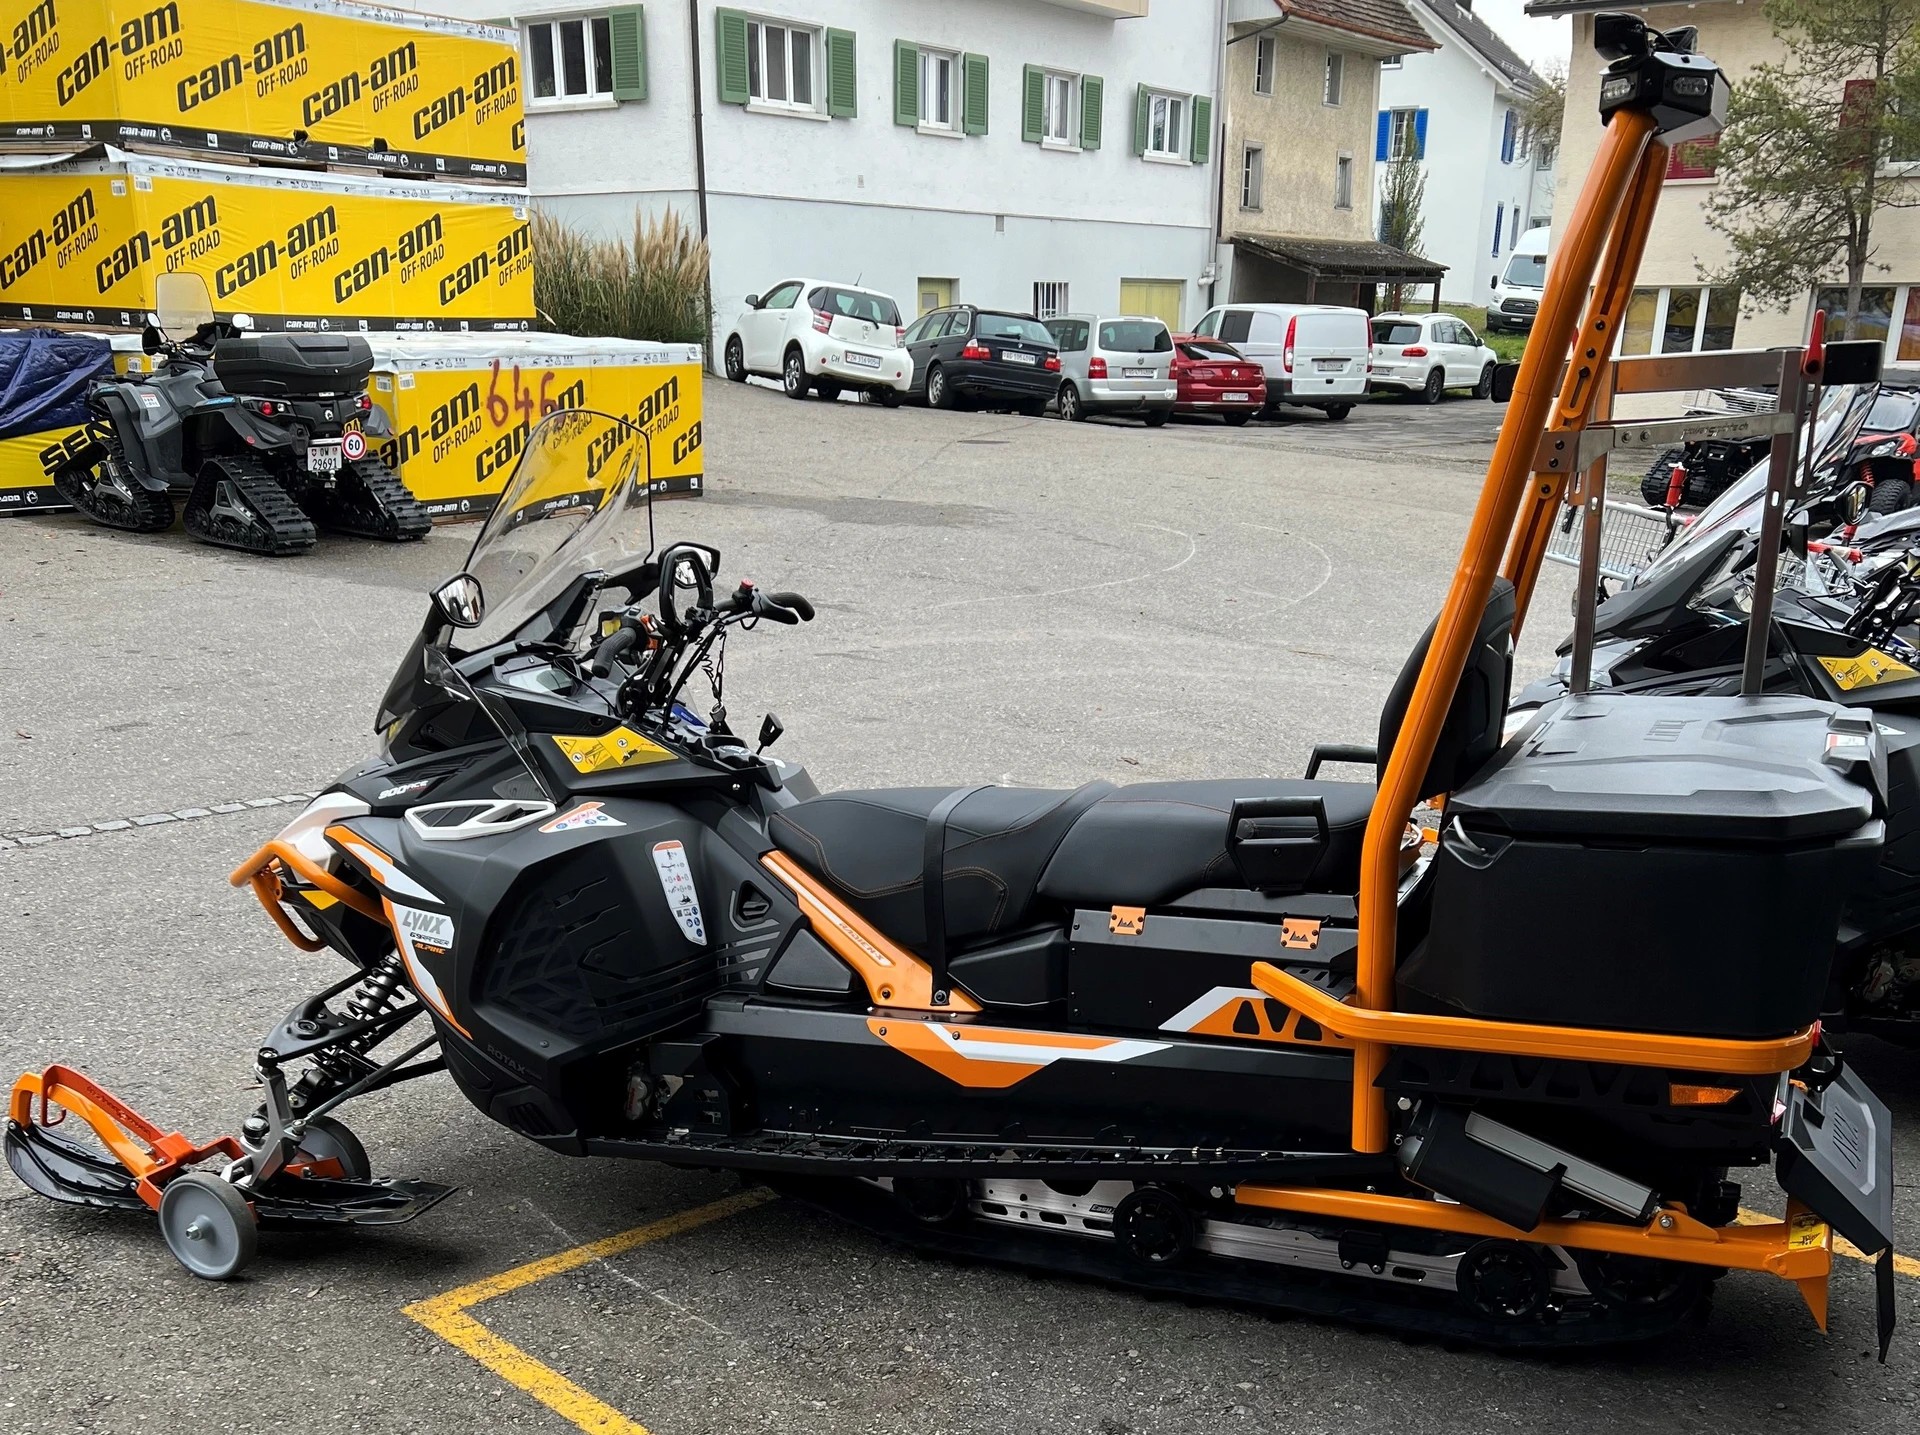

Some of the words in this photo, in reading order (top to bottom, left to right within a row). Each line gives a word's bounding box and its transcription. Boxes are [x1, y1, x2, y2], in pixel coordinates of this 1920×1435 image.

[17, 31, 60, 83] OFF-ROAD
[57, 1, 181, 107] can-am
[124, 37, 183, 81] OFF-ROAD
[177, 22, 306, 112] can-am
[257, 57, 308, 98] OFF-ROAD
[302, 41, 417, 128] can-am
[372, 74, 419, 114] OFF-ROAD
[413, 56, 516, 140] can-am
[475, 88, 517, 126] OFF-ROAD
[119, 126, 157, 138] can-am
[252, 140, 284, 151] can-am
[0, 187, 96, 290] can-am
[57, 222, 99, 269] OFF-ROAD
[96, 194, 217, 294] can-am
[165, 229, 221, 273] OFF-ROAD
[216, 205, 337, 299] can-am
[290, 238, 339, 280] OFF-ROAD
[334, 213, 442, 304] can-am
[400, 243, 445, 285] OFF-ROAD
[499, 251, 533, 287] OFF-ROA
[348, 439, 361, 451] 60
[378, 382, 480, 471] an-am
[432, 414, 483, 464] OFF-ROAD
[312, 458, 338, 471] 29691
[427, 503, 458, 513] can-am
[402, 910, 447, 934] LYNX
[487, 1044, 526, 1074] ROTAX
